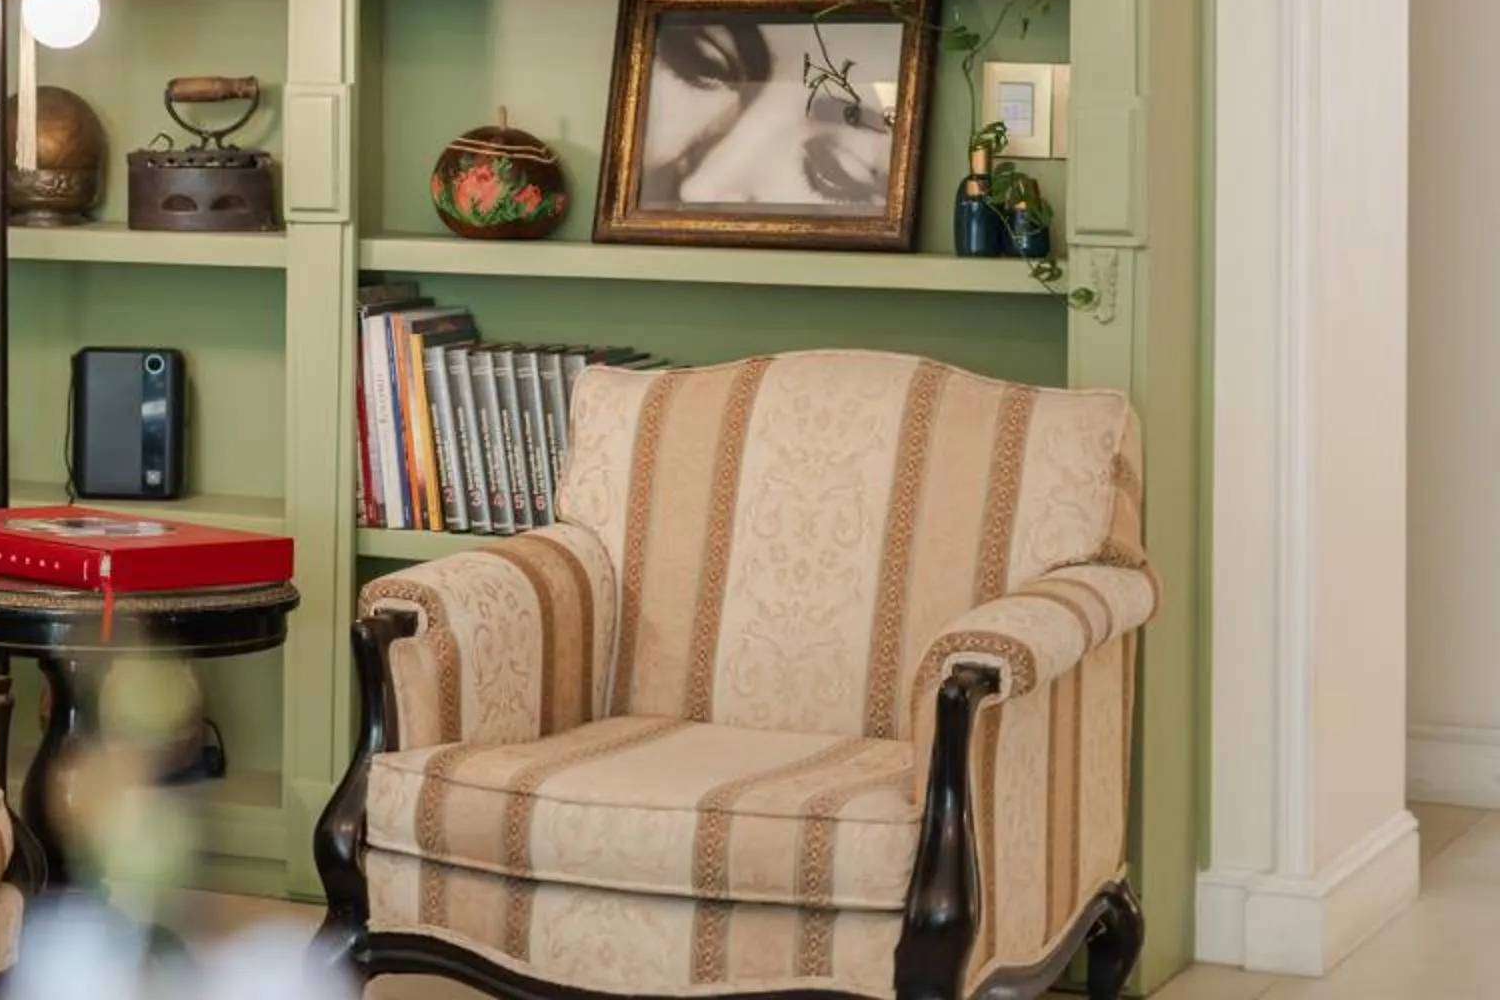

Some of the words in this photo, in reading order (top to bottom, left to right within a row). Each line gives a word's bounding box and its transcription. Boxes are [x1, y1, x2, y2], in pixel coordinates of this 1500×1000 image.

[470, 491, 482, 507] 3
[493, 494, 504, 507] 4
[514, 494, 524, 509] 5
[535, 495, 545, 511] 6
